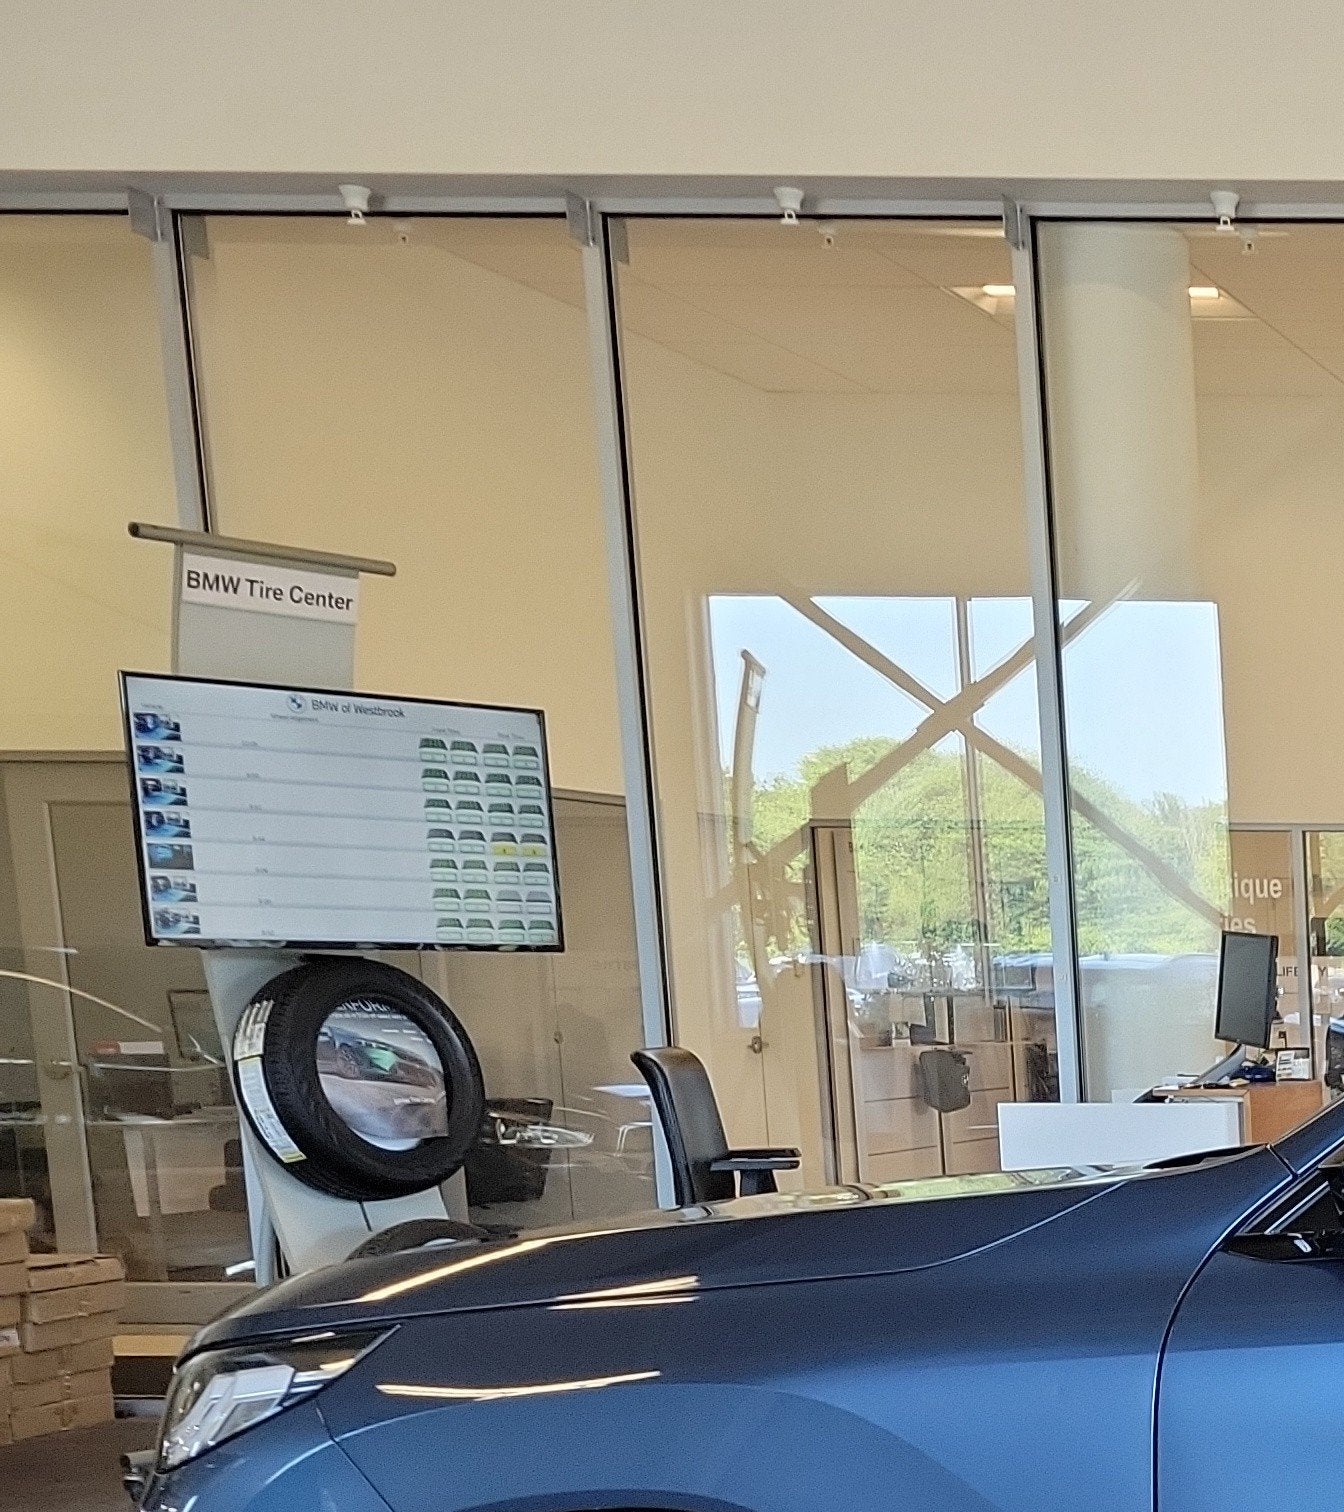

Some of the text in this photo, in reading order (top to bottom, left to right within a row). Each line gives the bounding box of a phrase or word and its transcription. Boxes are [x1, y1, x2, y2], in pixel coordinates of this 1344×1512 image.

[186, 569, 354, 611] BMW Tire Center
[311, 699, 405, 718] BMW of Westbrook
